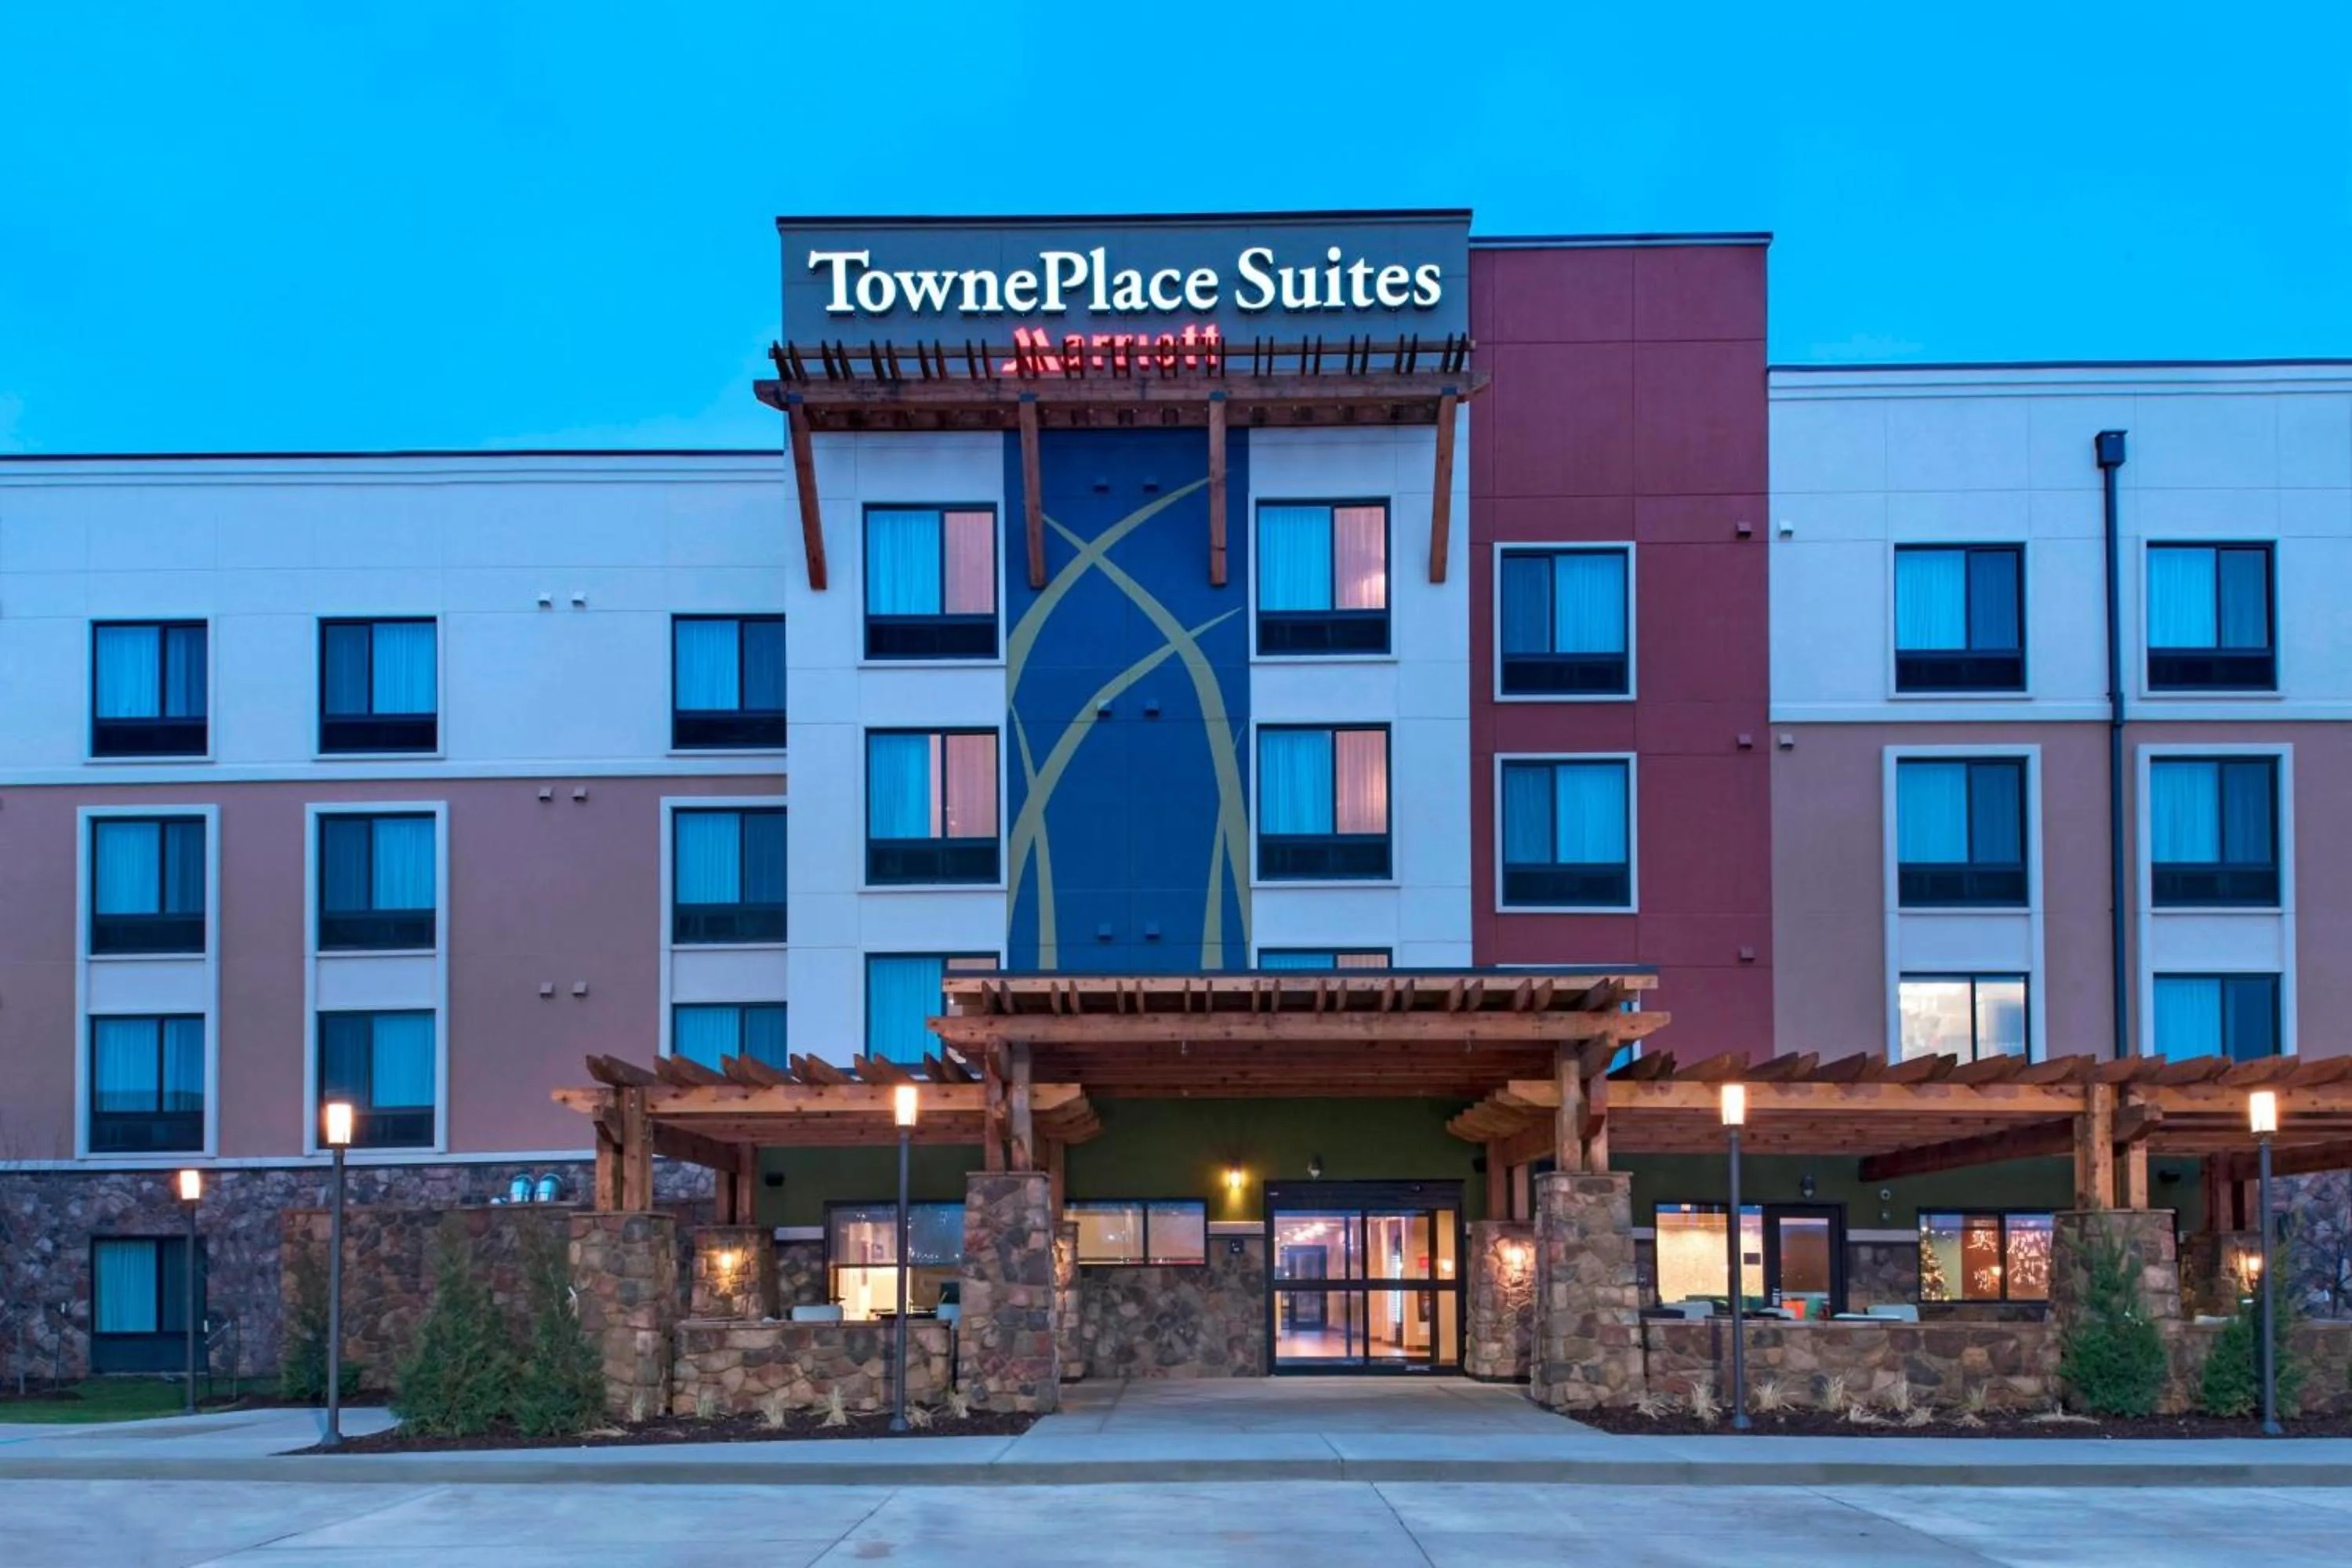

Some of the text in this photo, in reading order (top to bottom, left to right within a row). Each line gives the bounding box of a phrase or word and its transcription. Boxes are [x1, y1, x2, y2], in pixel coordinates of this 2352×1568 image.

[808, 246, 1442, 312] TownePlace Suites
[1001, 324, 1220, 372] Marriott
